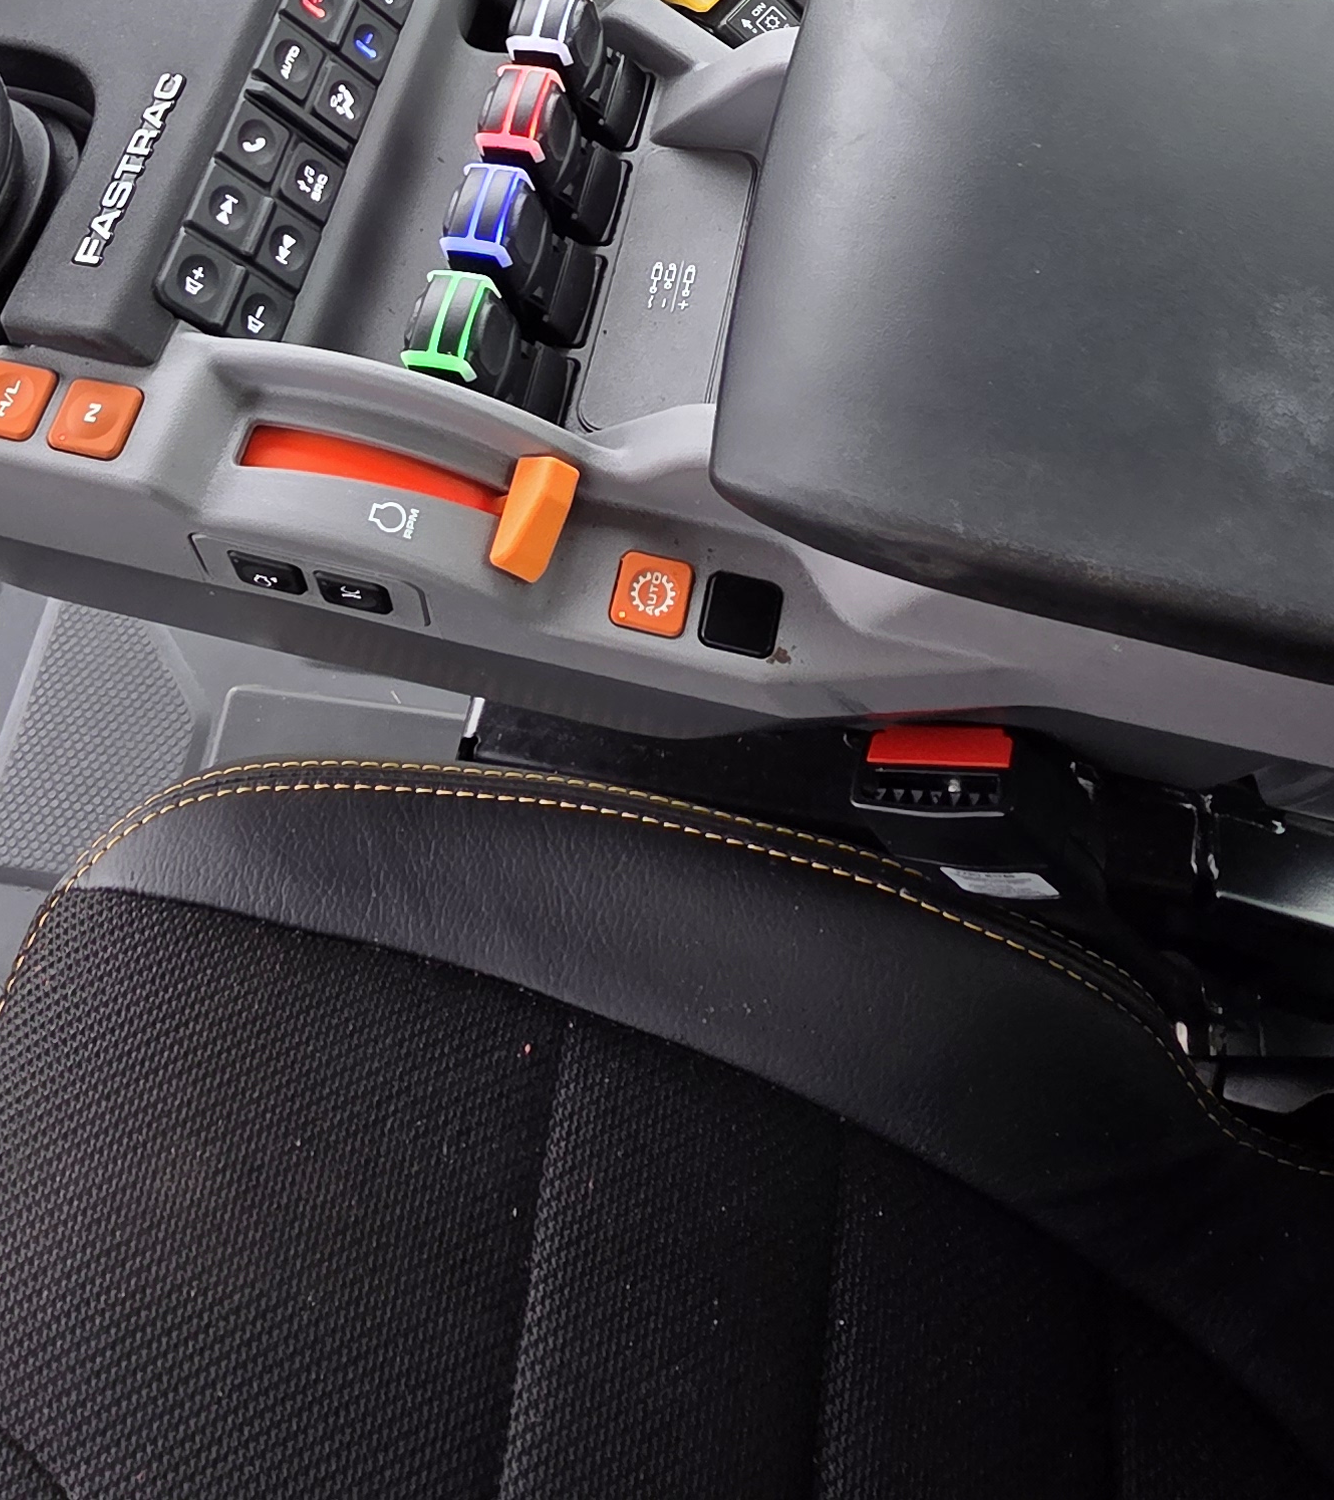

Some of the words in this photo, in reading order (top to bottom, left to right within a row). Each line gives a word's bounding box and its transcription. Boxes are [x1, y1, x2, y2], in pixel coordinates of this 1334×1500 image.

[751, 2, 766, 16] ON
[280, 45, 301, 80] AUTO
[73, 72, 185, 266] FASTRAC
[403, 508, 420, 539] RPM
[645, 571, 662, 616] AUTO
